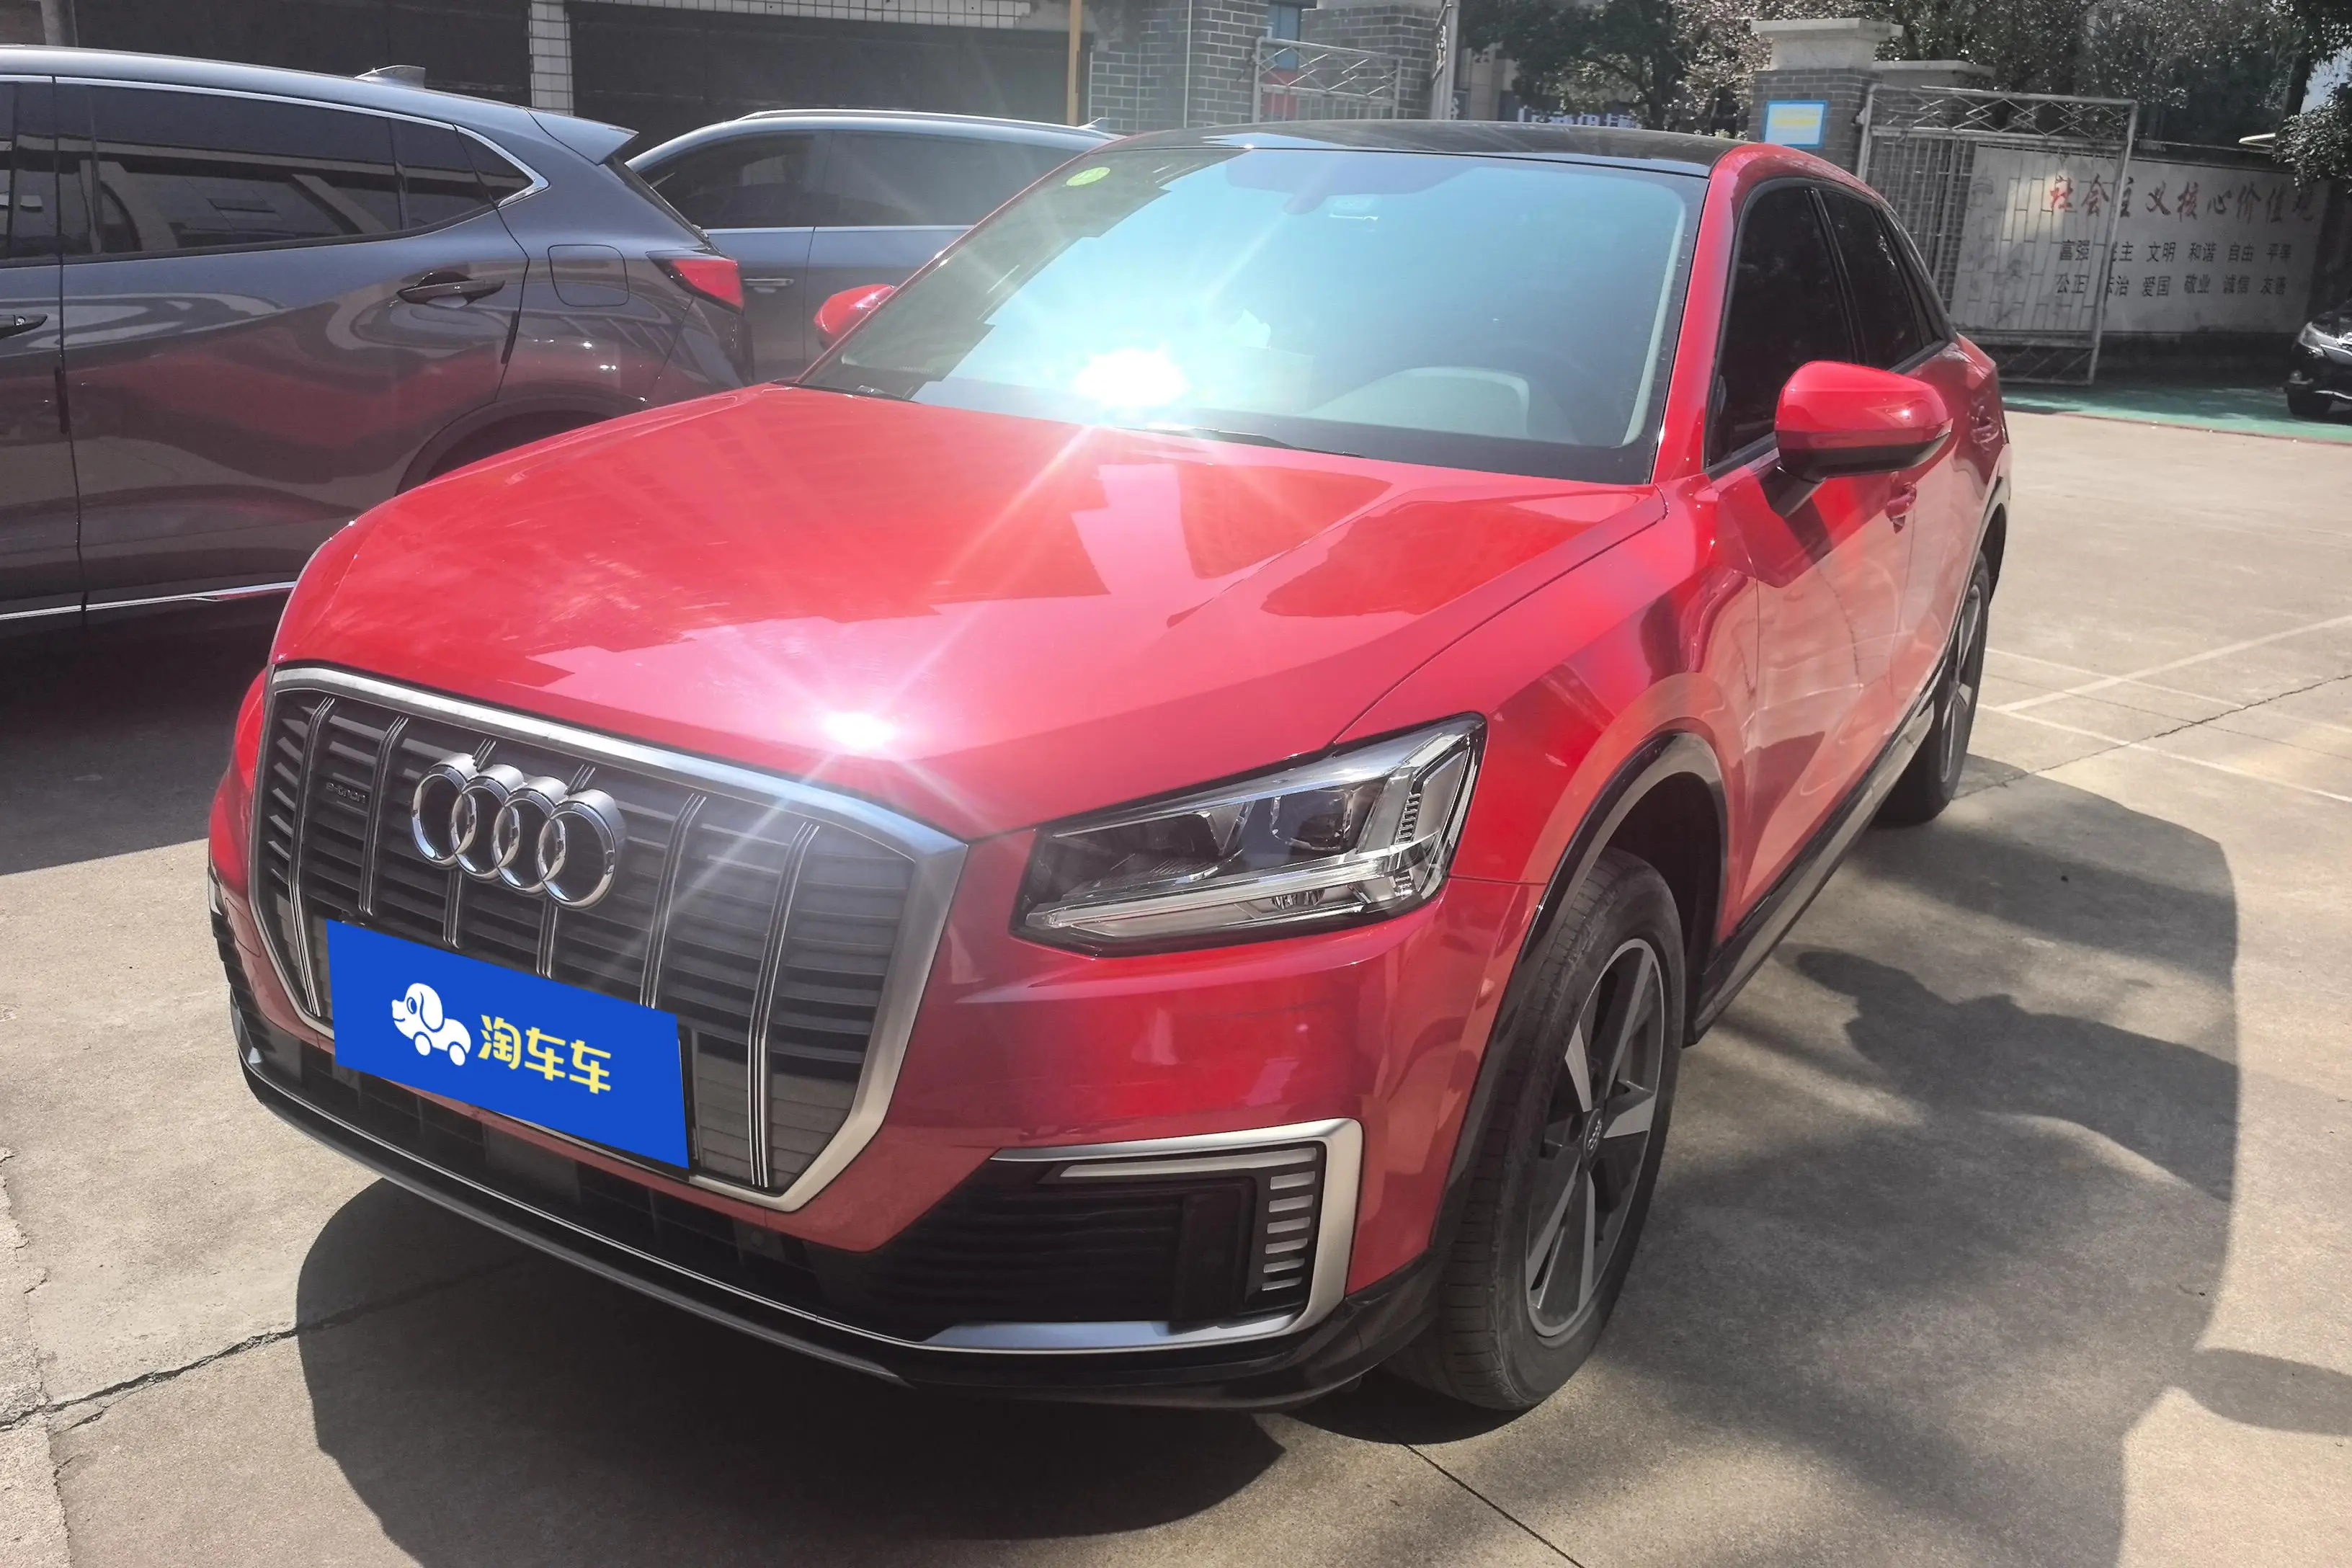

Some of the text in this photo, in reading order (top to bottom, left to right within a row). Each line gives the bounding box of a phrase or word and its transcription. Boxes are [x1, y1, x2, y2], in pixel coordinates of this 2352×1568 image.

[2059, 239, 2090, 261] 富强
[2146, 241, 2176, 262] 文明
[2188, 242, 2217, 262] 和谐
[2227, 242, 2255, 262] 自由
[2266, 243, 2292, 262] 平等
[2055, 273, 2090, 294] 公正
[2142, 276, 2171, 297] 爱国
[2183, 275, 2211, 295] 敬业
[2223, 275, 2251, 295] 诚信
[2260, 275, 2287, 295] 友善
